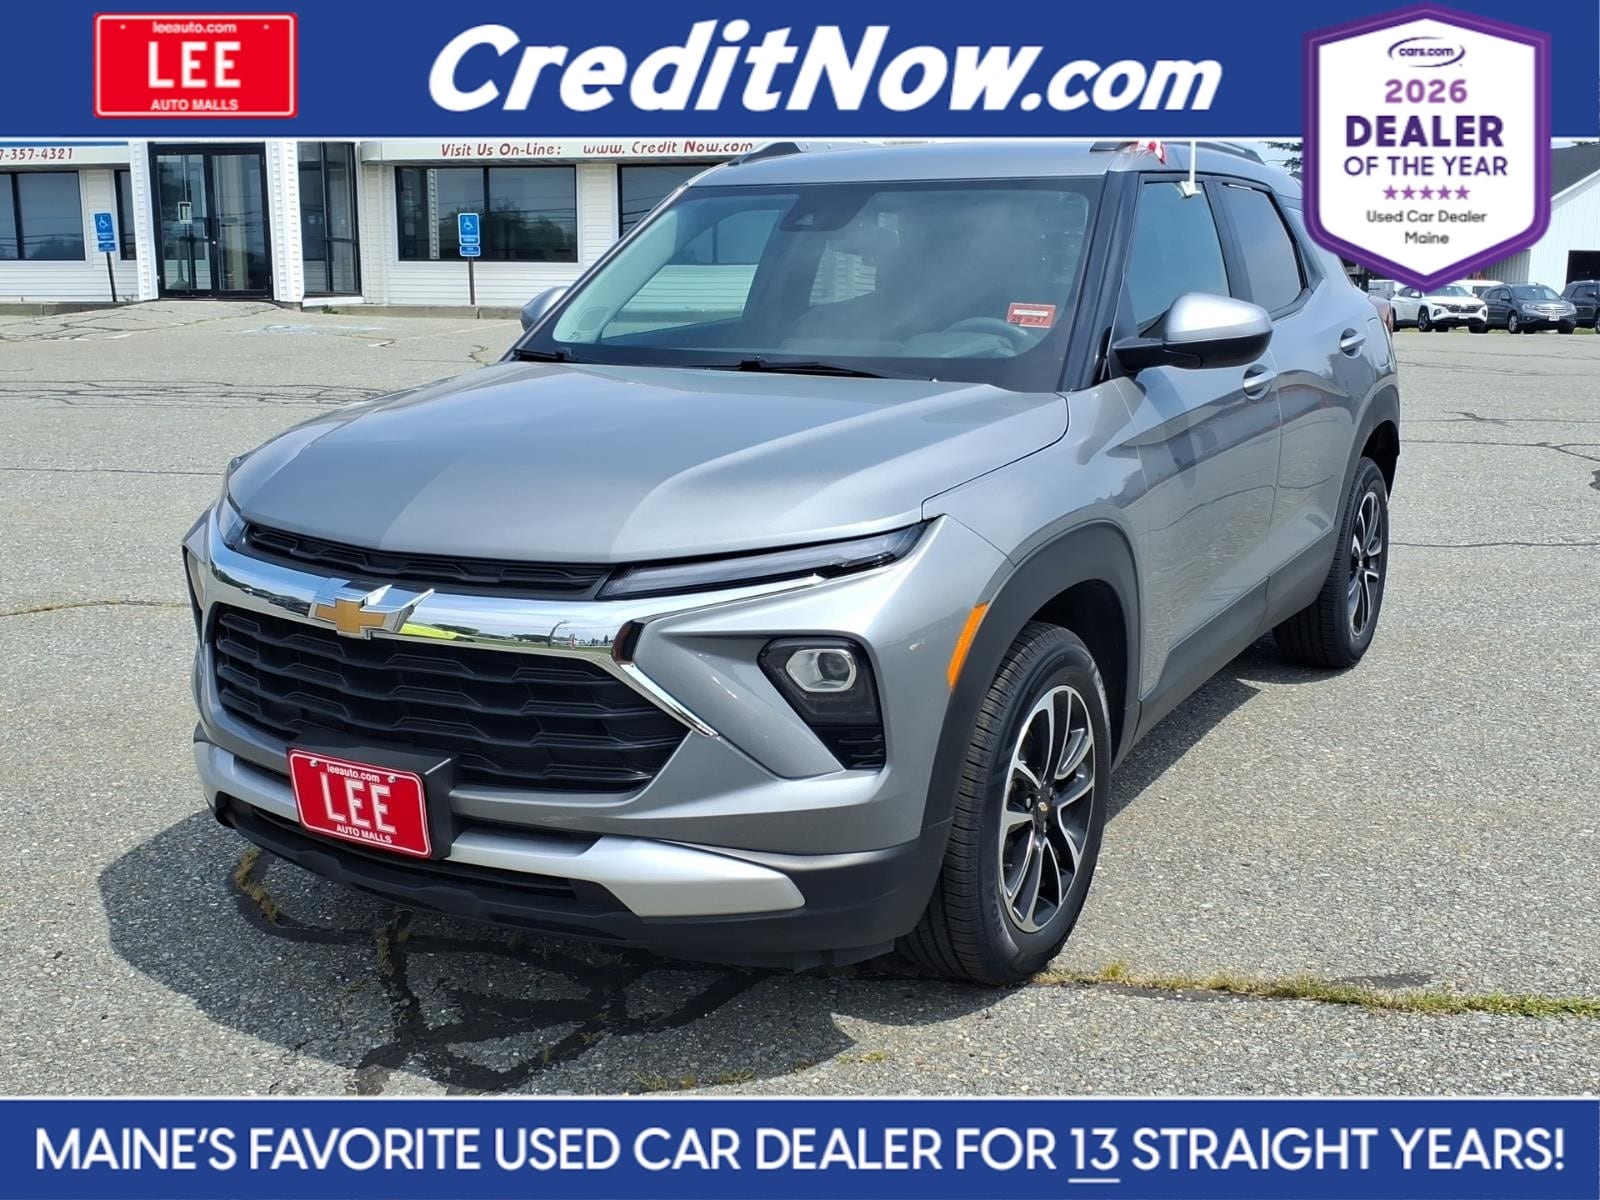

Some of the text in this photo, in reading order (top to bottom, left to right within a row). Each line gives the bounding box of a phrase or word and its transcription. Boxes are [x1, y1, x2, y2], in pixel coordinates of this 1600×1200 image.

[441, 140, 753, 156] Visit Us On-Line: www. Credit Now.com
[327, 763, 380, 783] leeauto.com
[320, 773, 396, 833] LEE
[336, 823, 392, 843] AUTO MALLS
